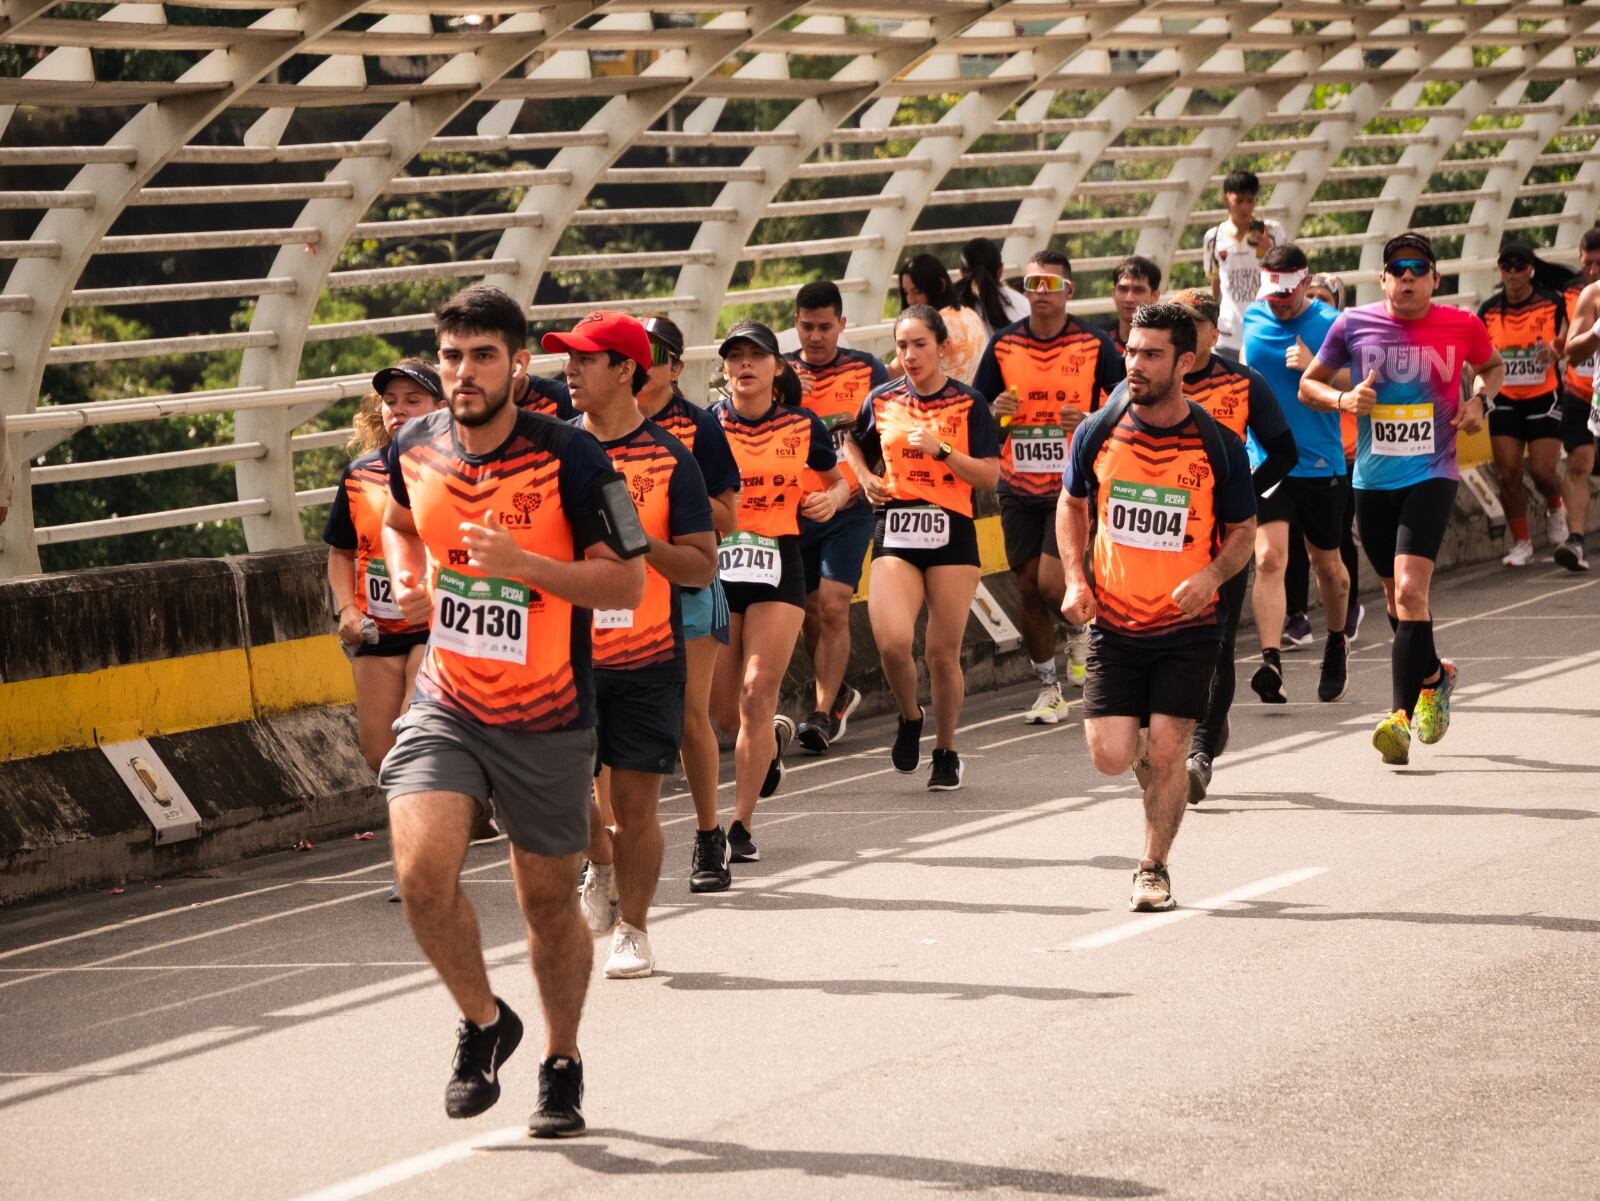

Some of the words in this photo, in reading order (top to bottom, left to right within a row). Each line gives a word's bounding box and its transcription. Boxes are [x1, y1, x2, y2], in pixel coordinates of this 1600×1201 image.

[1361, 345, 1455, 383] RUN
[1375, 421, 1432, 443] 03242
[1015, 443, 1064, 461] 01455
[1178, 474, 1196, 487] fcv
[500, 512, 523, 525] fcv
[890, 512, 945, 533] 02705
[1113, 505, 1182, 536] 01904
[719, 547, 774, 571] 02747
[440, 596, 521, 640] 02130
